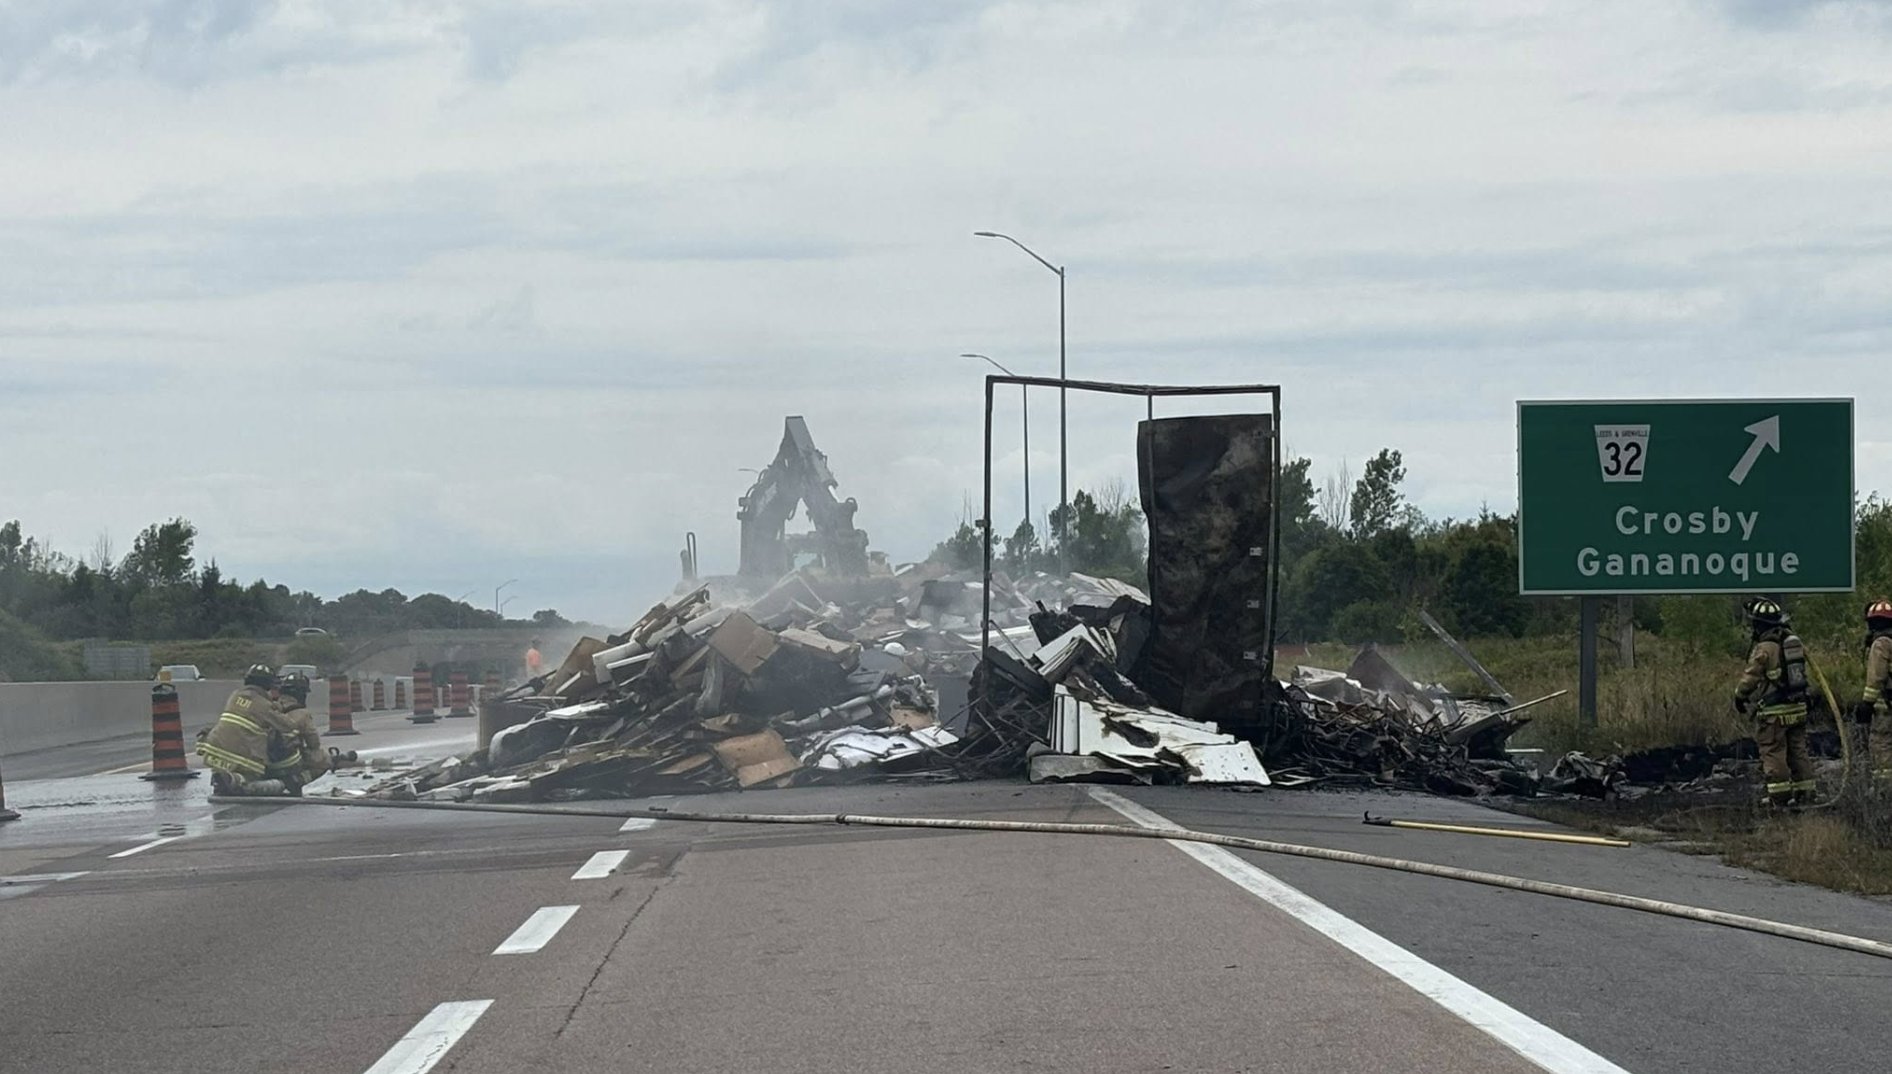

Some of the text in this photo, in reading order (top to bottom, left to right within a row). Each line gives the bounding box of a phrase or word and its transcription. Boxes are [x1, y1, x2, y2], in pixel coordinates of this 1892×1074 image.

[1604, 441, 1642, 476] 32
[1615, 506, 1758, 541] Crosby
[1577, 547, 1799, 582] Gananoque
